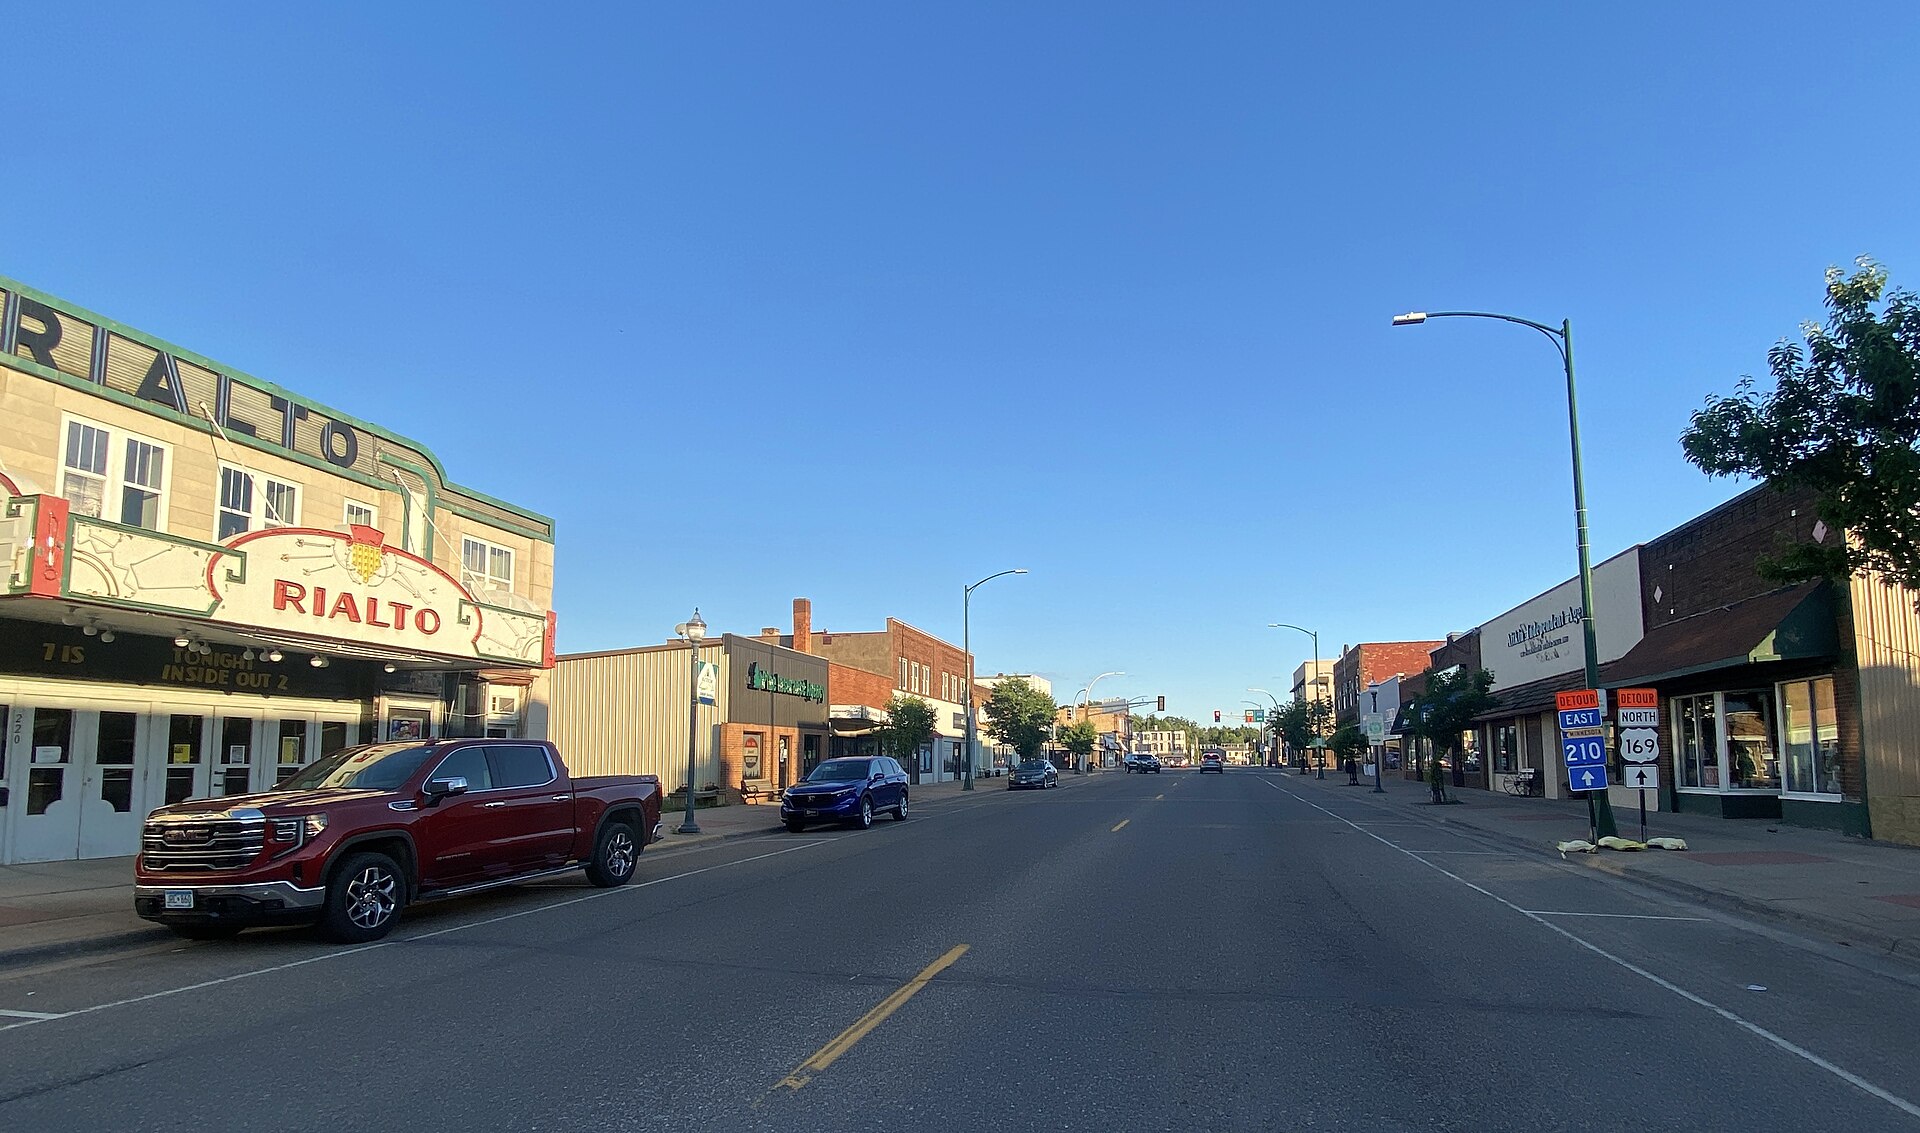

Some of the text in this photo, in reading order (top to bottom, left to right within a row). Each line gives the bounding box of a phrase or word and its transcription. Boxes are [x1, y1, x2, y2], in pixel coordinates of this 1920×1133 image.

[0, 290, 359, 468] RIALTO
[273, 578, 441, 635] RIALTO
[162, 664, 289, 690] INSIDE OUT 2
[1560, 694, 1596, 706] DETOUR
[1621, 693, 1655, 704] DETOUR
[1565, 713, 1594, 725] EAST
[1622, 711, 1656, 722] NORTH
[14, 713, 23, 744] 220
[1566, 742, 1601, 762] 210
[1626, 739, 1655, 754] 169
[163, 829, 210, 841] GMC
